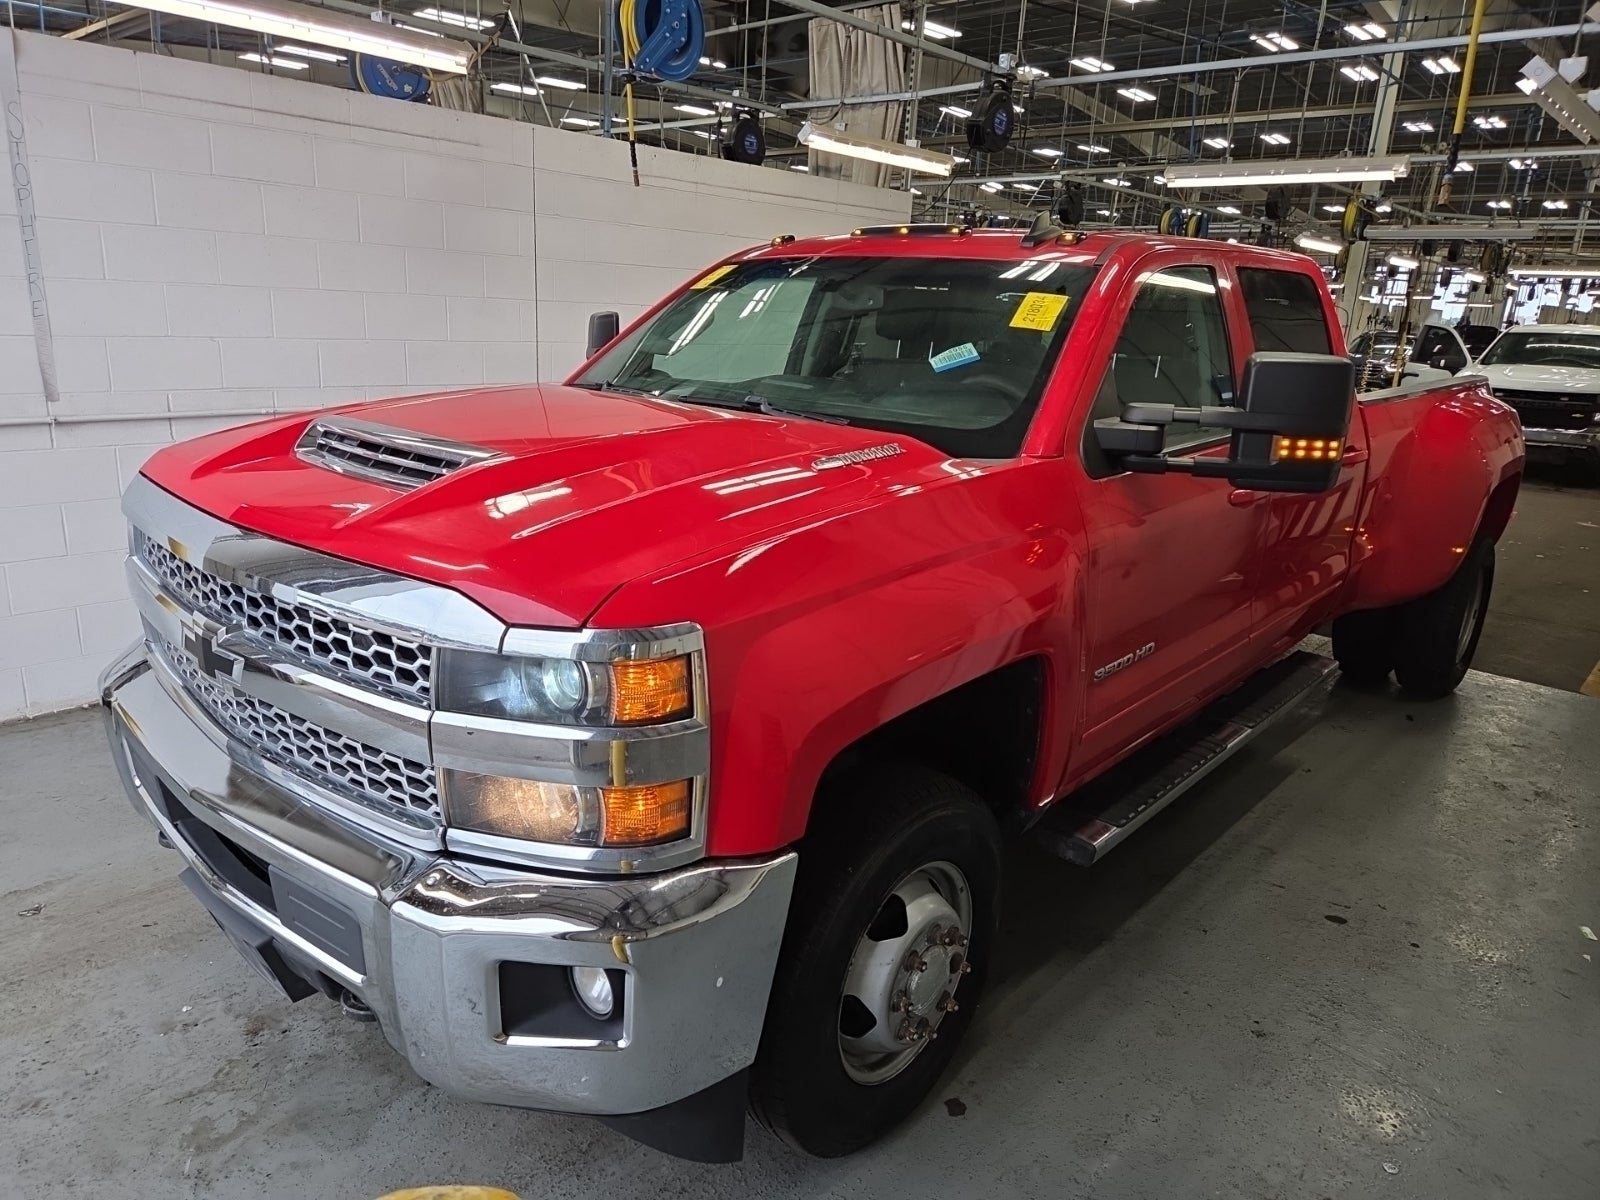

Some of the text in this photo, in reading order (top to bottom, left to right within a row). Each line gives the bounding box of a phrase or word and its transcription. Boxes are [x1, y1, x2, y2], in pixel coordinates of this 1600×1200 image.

[8, 101, 45, 318] STOP HERE
[1094, 641, 1155, 682] 3500 HD
